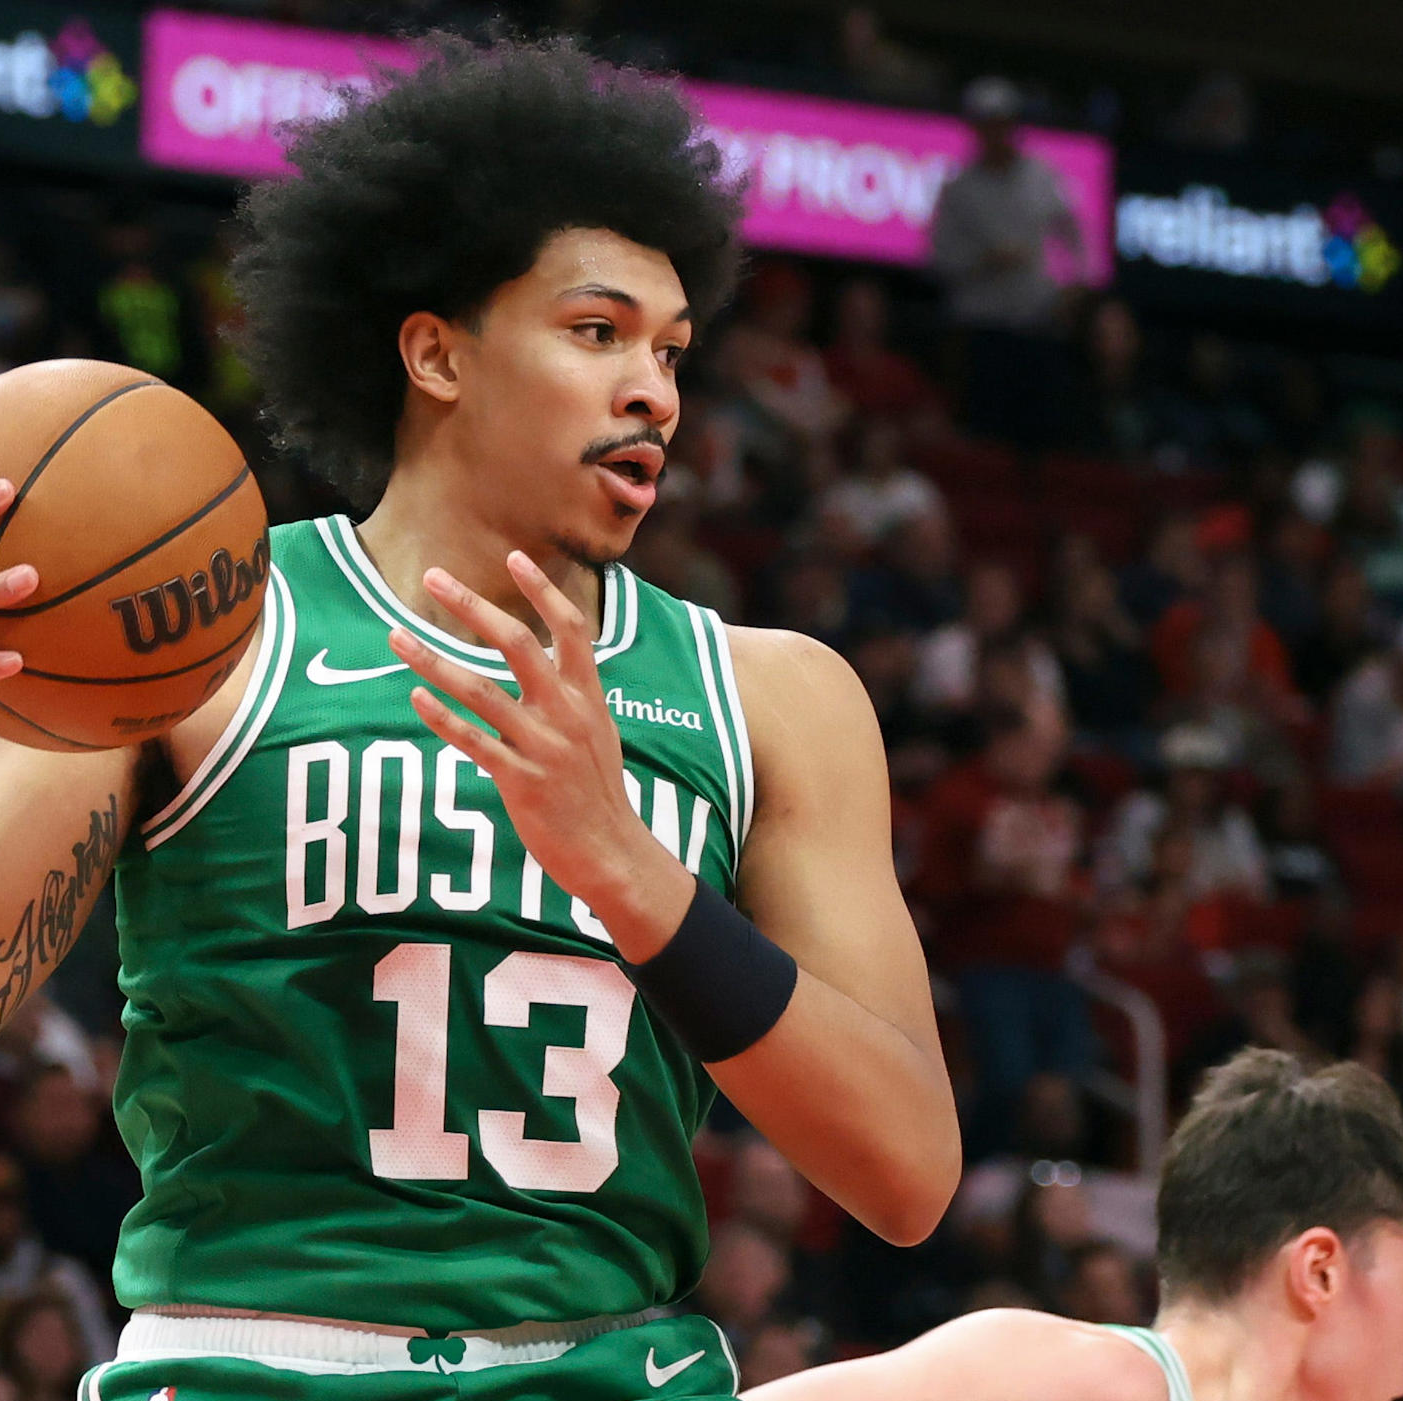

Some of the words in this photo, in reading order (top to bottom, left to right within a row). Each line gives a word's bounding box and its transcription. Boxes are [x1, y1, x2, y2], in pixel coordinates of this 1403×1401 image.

[1114, 186, 1330, 286] reliant
[109, 530, 270, 654] Wilso
[605, 687, 704, 731] Amica
[368, 942, 637, 1193] 13
